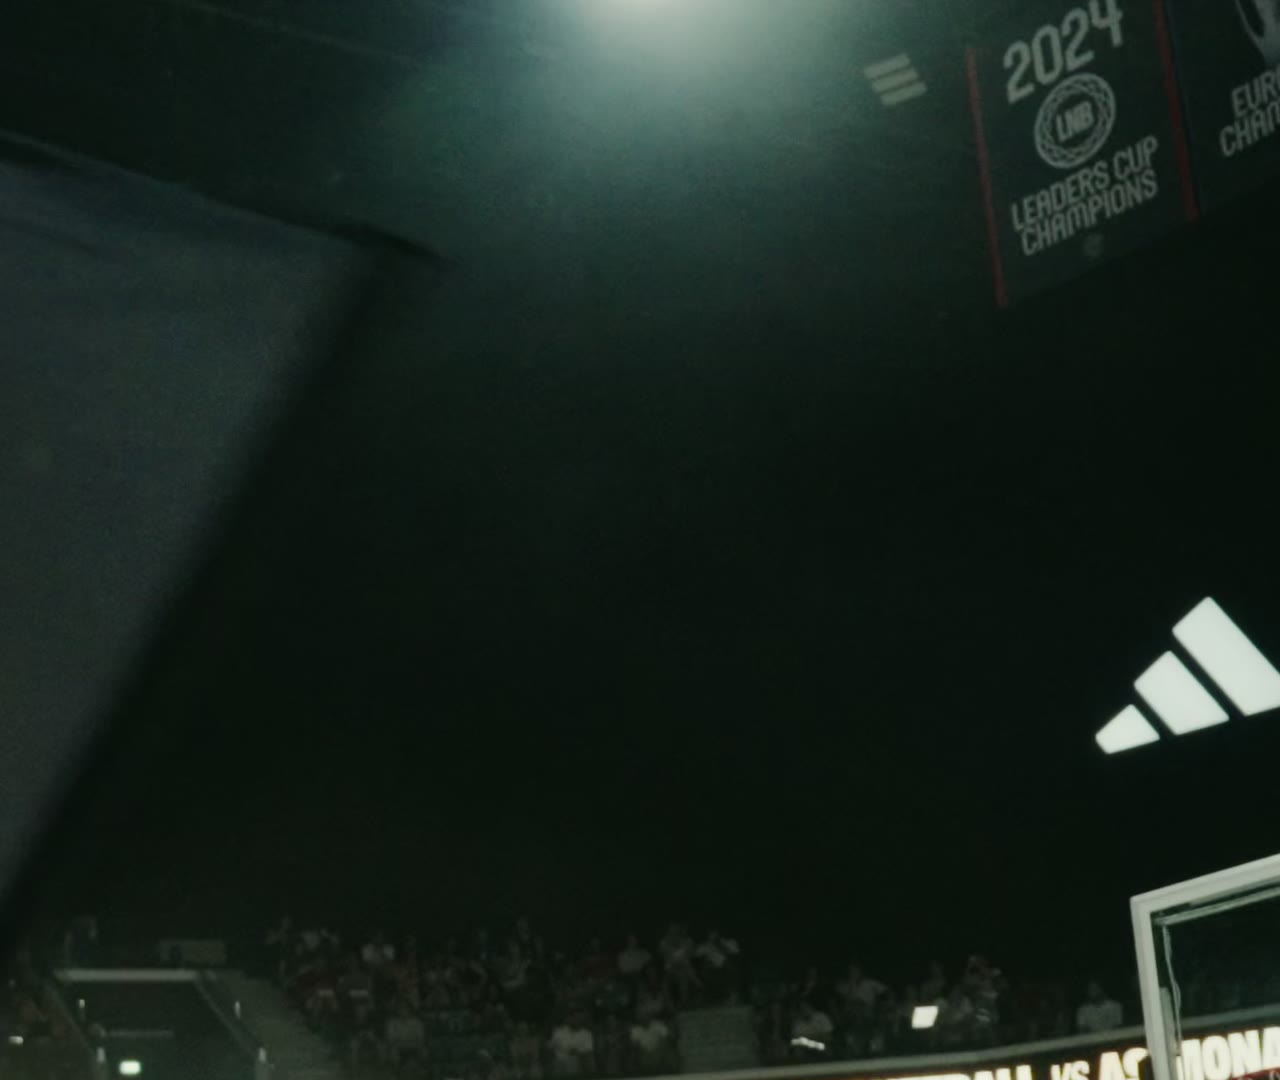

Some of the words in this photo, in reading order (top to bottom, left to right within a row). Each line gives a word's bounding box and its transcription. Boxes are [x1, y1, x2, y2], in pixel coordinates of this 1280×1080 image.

[1003, 0, 1123, 104] 2024
[1230, 66, 1280, 118] EUR
[1054, 102, 1095, 143] LNB
[1011, 158, 1110, 232] LEADERS
[1113, 135, 1159, 180] CUP
[1021, 169, 1158, 256] CHAMPIONS
